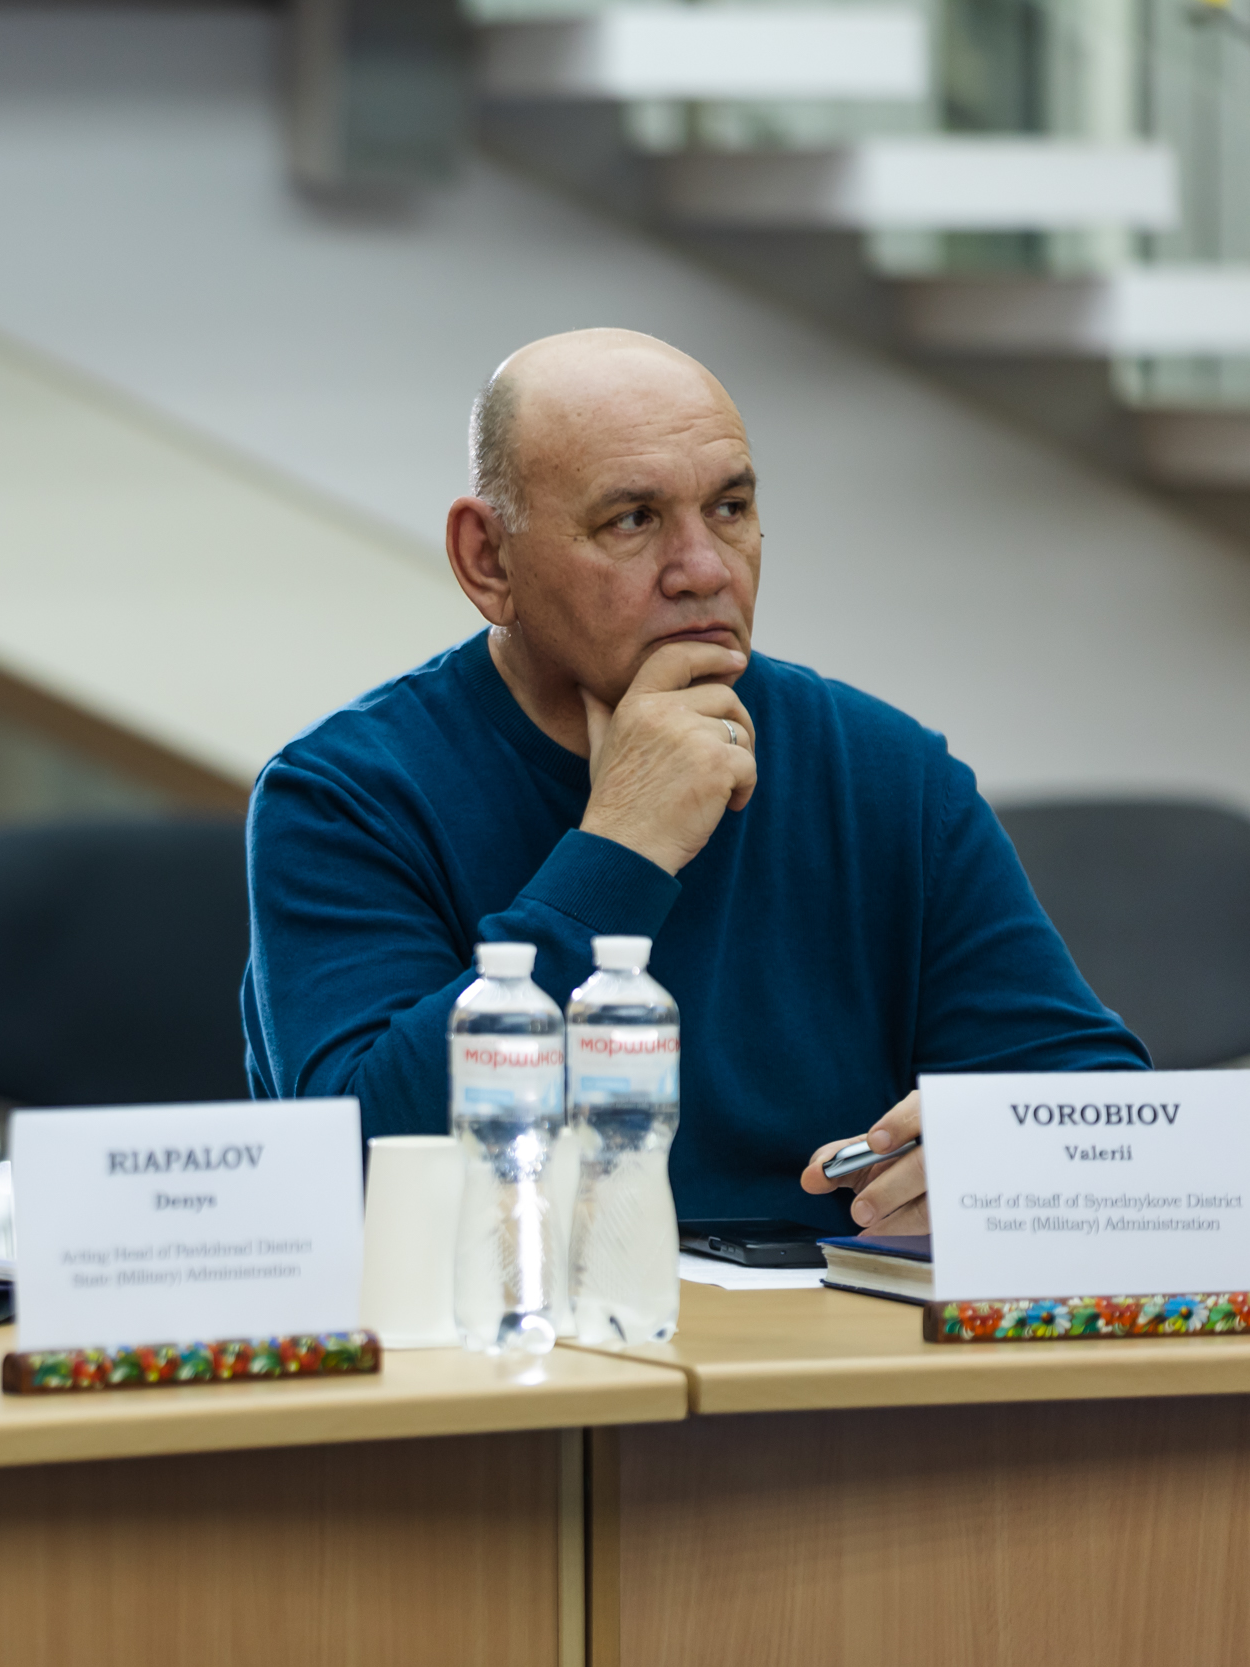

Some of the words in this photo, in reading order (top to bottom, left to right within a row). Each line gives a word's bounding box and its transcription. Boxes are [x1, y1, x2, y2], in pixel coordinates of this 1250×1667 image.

[1011, 1104, 1181, 1126] VOROBIOV
[108, 1145, 265, 1175] RIAPALOV
[1065, 1145, 1133, 1161] Valerii
[155, 1190, 219, 1213] Denys
[961, 1194, 1003, 1208] Chief
[1007, 1194, 1022, 1208] of
[1025, 1194, 1063, 1208] Staff
[1066, 1194, 1081, 1208] of
[1084, 1193, 1182, 1212] Synelnykove
[1186, 1193, 1242, 1208] District
[986, 1216, 1027, 1231] State
[1032, 1216, 1099, 1234] (Military)
[1105, 1215, 1220, 1231] Administration
